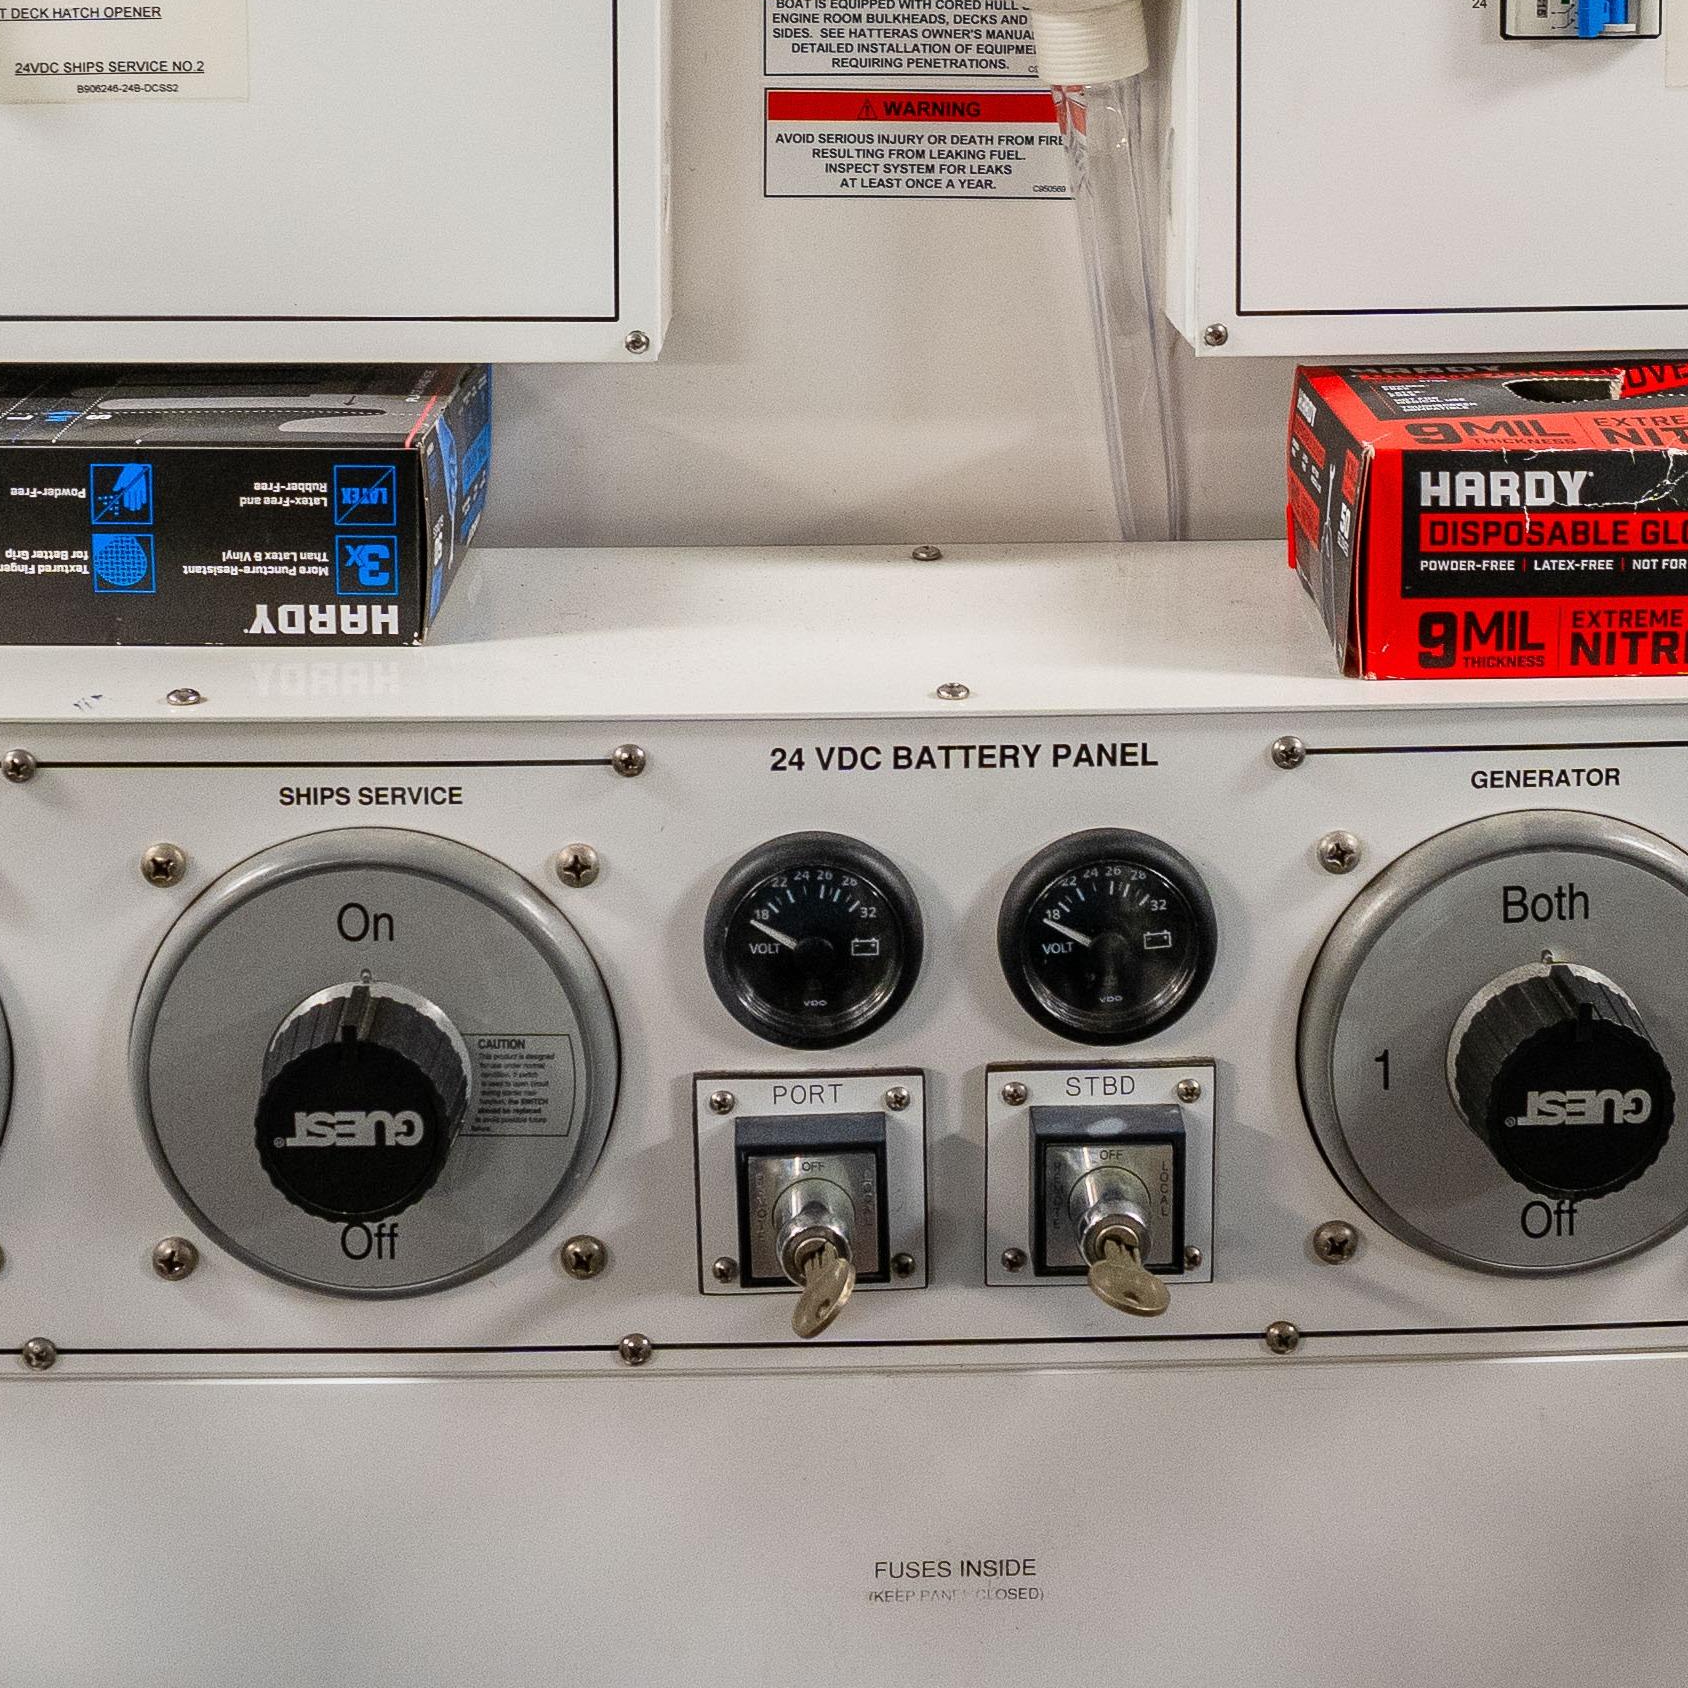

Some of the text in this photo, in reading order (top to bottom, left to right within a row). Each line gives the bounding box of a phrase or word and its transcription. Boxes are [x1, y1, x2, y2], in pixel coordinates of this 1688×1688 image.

[10, 7, 49, 21] DECK
[52, 7, 100, 19] HATCH
[103, 6, 162, 19] OPENER
[15, 60, 205, 75] 24VDC SHIPS SERVICE NO.2
[883, 101, 981, 118] WARNING
[775, 133, 815, 145] AVOID
[817, 133, 875, 145] SERIOUS
[877, 133, 925, 145] INJURY
[927, 134, 947, 145] OR
[950, 134, 995, 146] DEATH
[997, 134, 1035, 146] FROM
[825, 163, 1013, 176] INSPECT SYSTEM FOR LEAKS
[10, 486, 87, 499] Powder-Free
[1419, 470, 1589, 508] HARDY
[1428, 519, 1630, 547] DISPOSABLE
[38, 563, 90, 576] Textured
[1420, 558, 1515, 572] POWDER-FREE
[1533, 558, 1614, 571] LATEX-FREE
[1632, 558, 1659, 570] NOT
[1661, 558, 1688, 570] FOR
[255, 604, 400, 636] HARDY
[1572, 609, 1683, 629] EXTREME
[1418, 610, 1546, 670] 9 MIL
[770, 742, 1159, 772] 24 VDC BATTERY PANEL
[1470, 767, 1621, 789] GENERATOR
[279, 786, 463, 807] SHIPS SERVICE
[1502, 883, 1591, 926] Both
[337, 902, 396, 943] On
[1373, 1050, 1394, 1091] 1
[773, 1083, 844, 1105] PORT
[1065, 1076, 1136, 1098] STBD
[285, 1112, 424, 1149] GUEST
[1519, 1200, 1578, 1239] Off
[875, 1558, 1037, 1579] FUSES INSIDE
